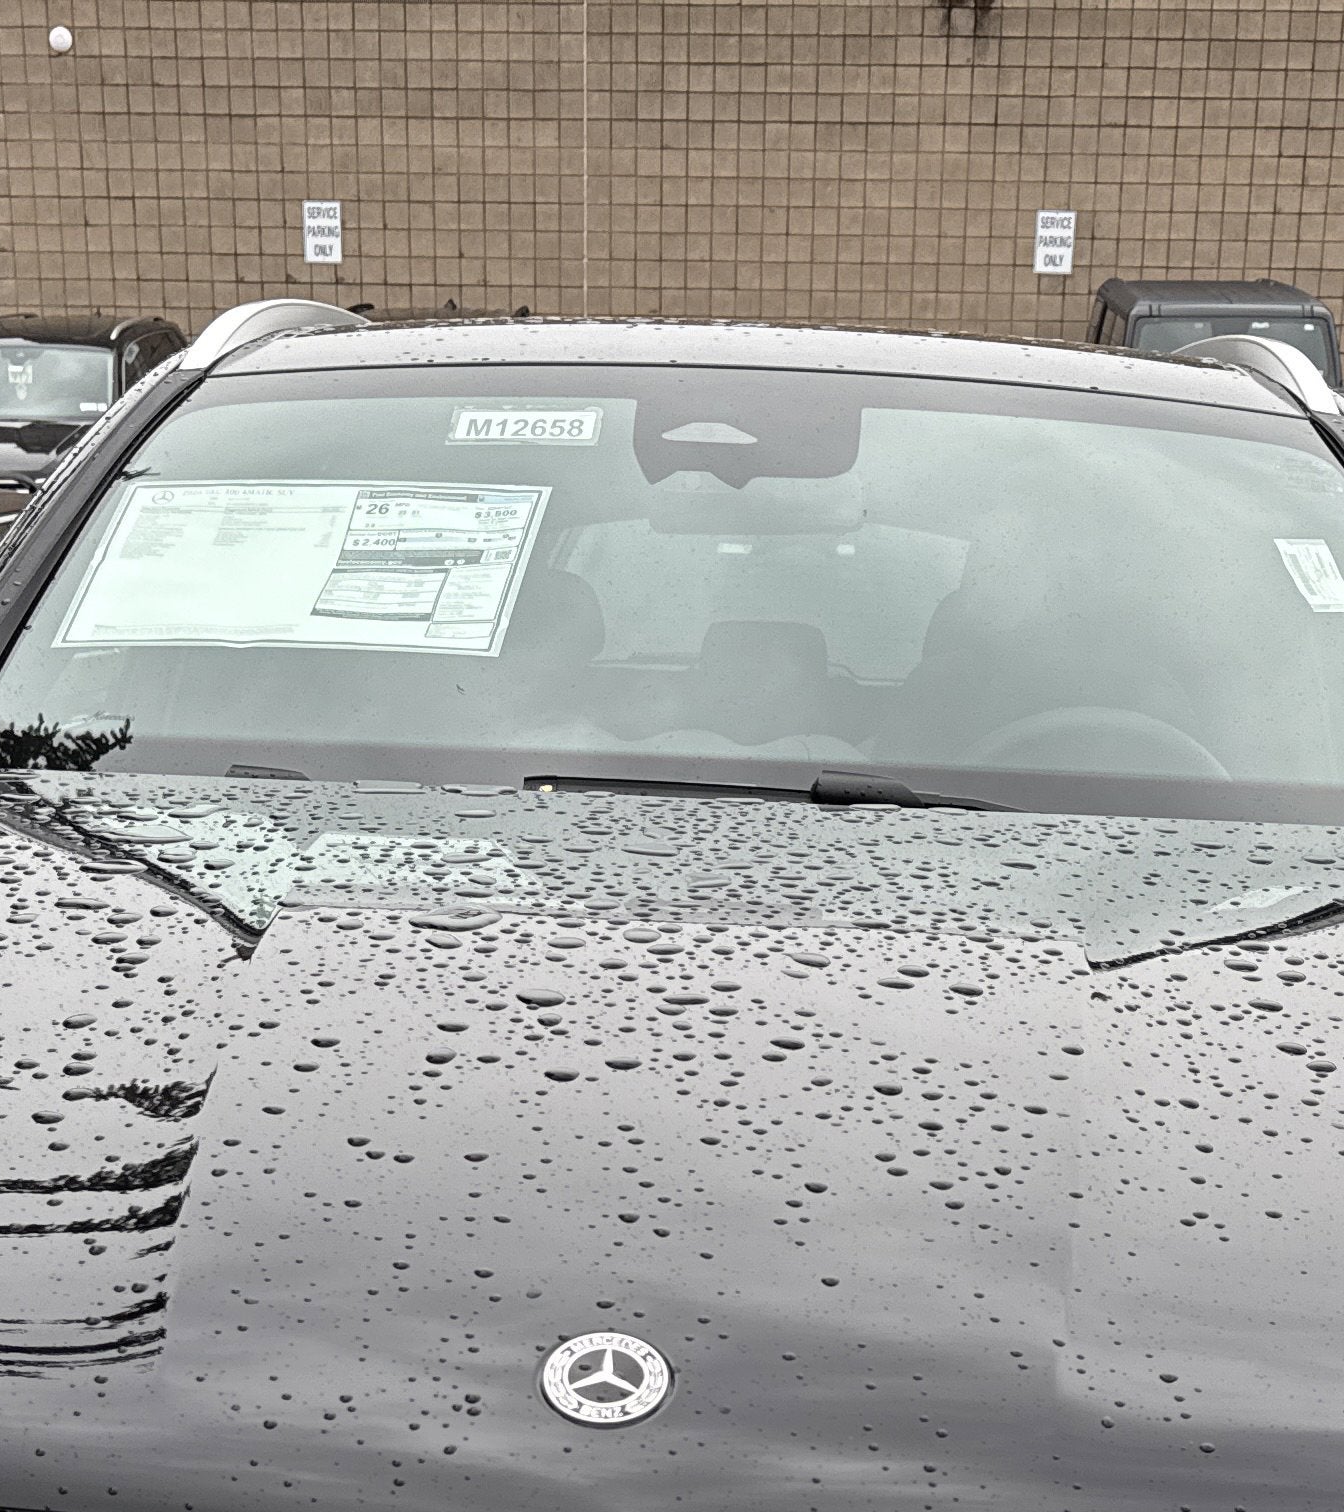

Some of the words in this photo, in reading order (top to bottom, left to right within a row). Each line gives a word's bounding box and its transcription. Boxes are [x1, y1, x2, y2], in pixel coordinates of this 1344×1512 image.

[307, 206, 338, 219] SERVICE
[1040, 216, 1072, 229] SERVICE
[306, 225, 339, 237] PARKING
[1039, 235, 1072, 248] PARKING
[314, 244, 333, 257] ONLY
[1043, 254, 1064, 267] ONLY
[465, 418, 584, 437] M12658
[365, 503, 390, 515] 26
[353, 538, 395, 547] $2,400
